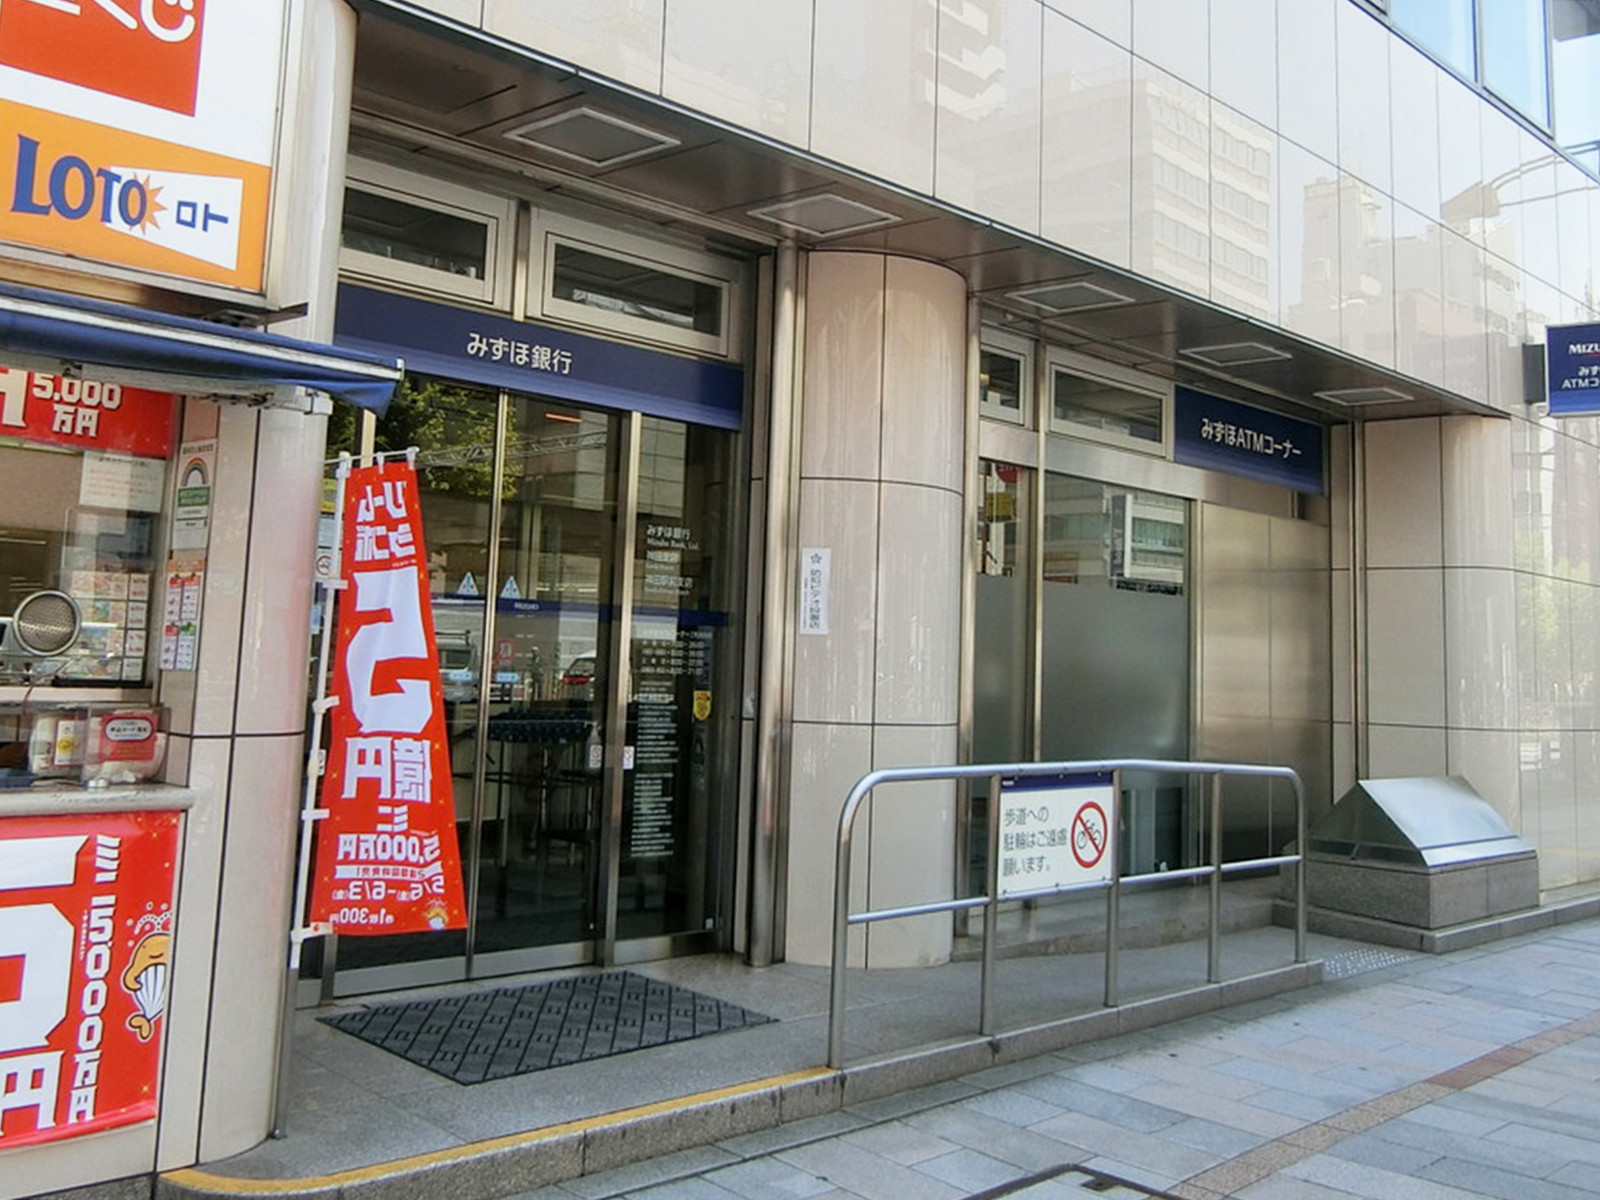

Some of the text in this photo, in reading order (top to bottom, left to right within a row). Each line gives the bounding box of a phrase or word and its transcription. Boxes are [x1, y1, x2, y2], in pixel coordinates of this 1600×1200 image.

[11, 133, 229, 232] LOTO ロト
[467, 332, 572, 374] みずほ銀行
[52, 403, 99, 437] 万円
[1201, 418, 1302, 459] みずほATMコーナー
[1004, 806, 1049, 827] 歩道への
[1003, 828, 1067, 852] 駐輪はご遠慮
[1003, 856, 1050, 877] 願います。
